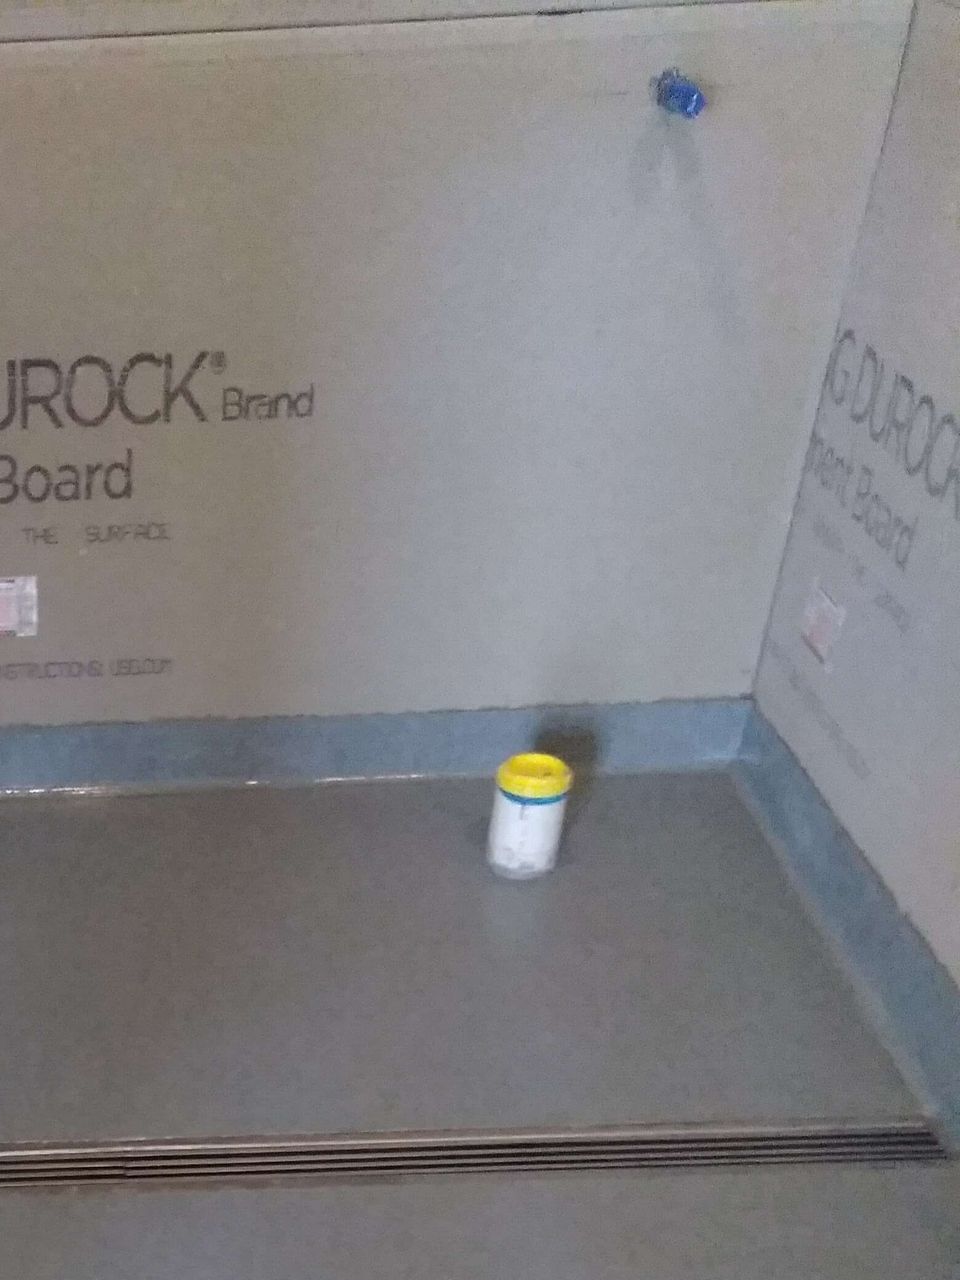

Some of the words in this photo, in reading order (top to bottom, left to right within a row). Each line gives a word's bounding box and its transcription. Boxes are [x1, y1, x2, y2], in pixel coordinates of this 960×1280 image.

[222, 383, 314, 421] Brand
[21, 525, 60, 545] THE
[84, 521, 171, 544] SURFACE
[851, 463, 919, 573] Board
